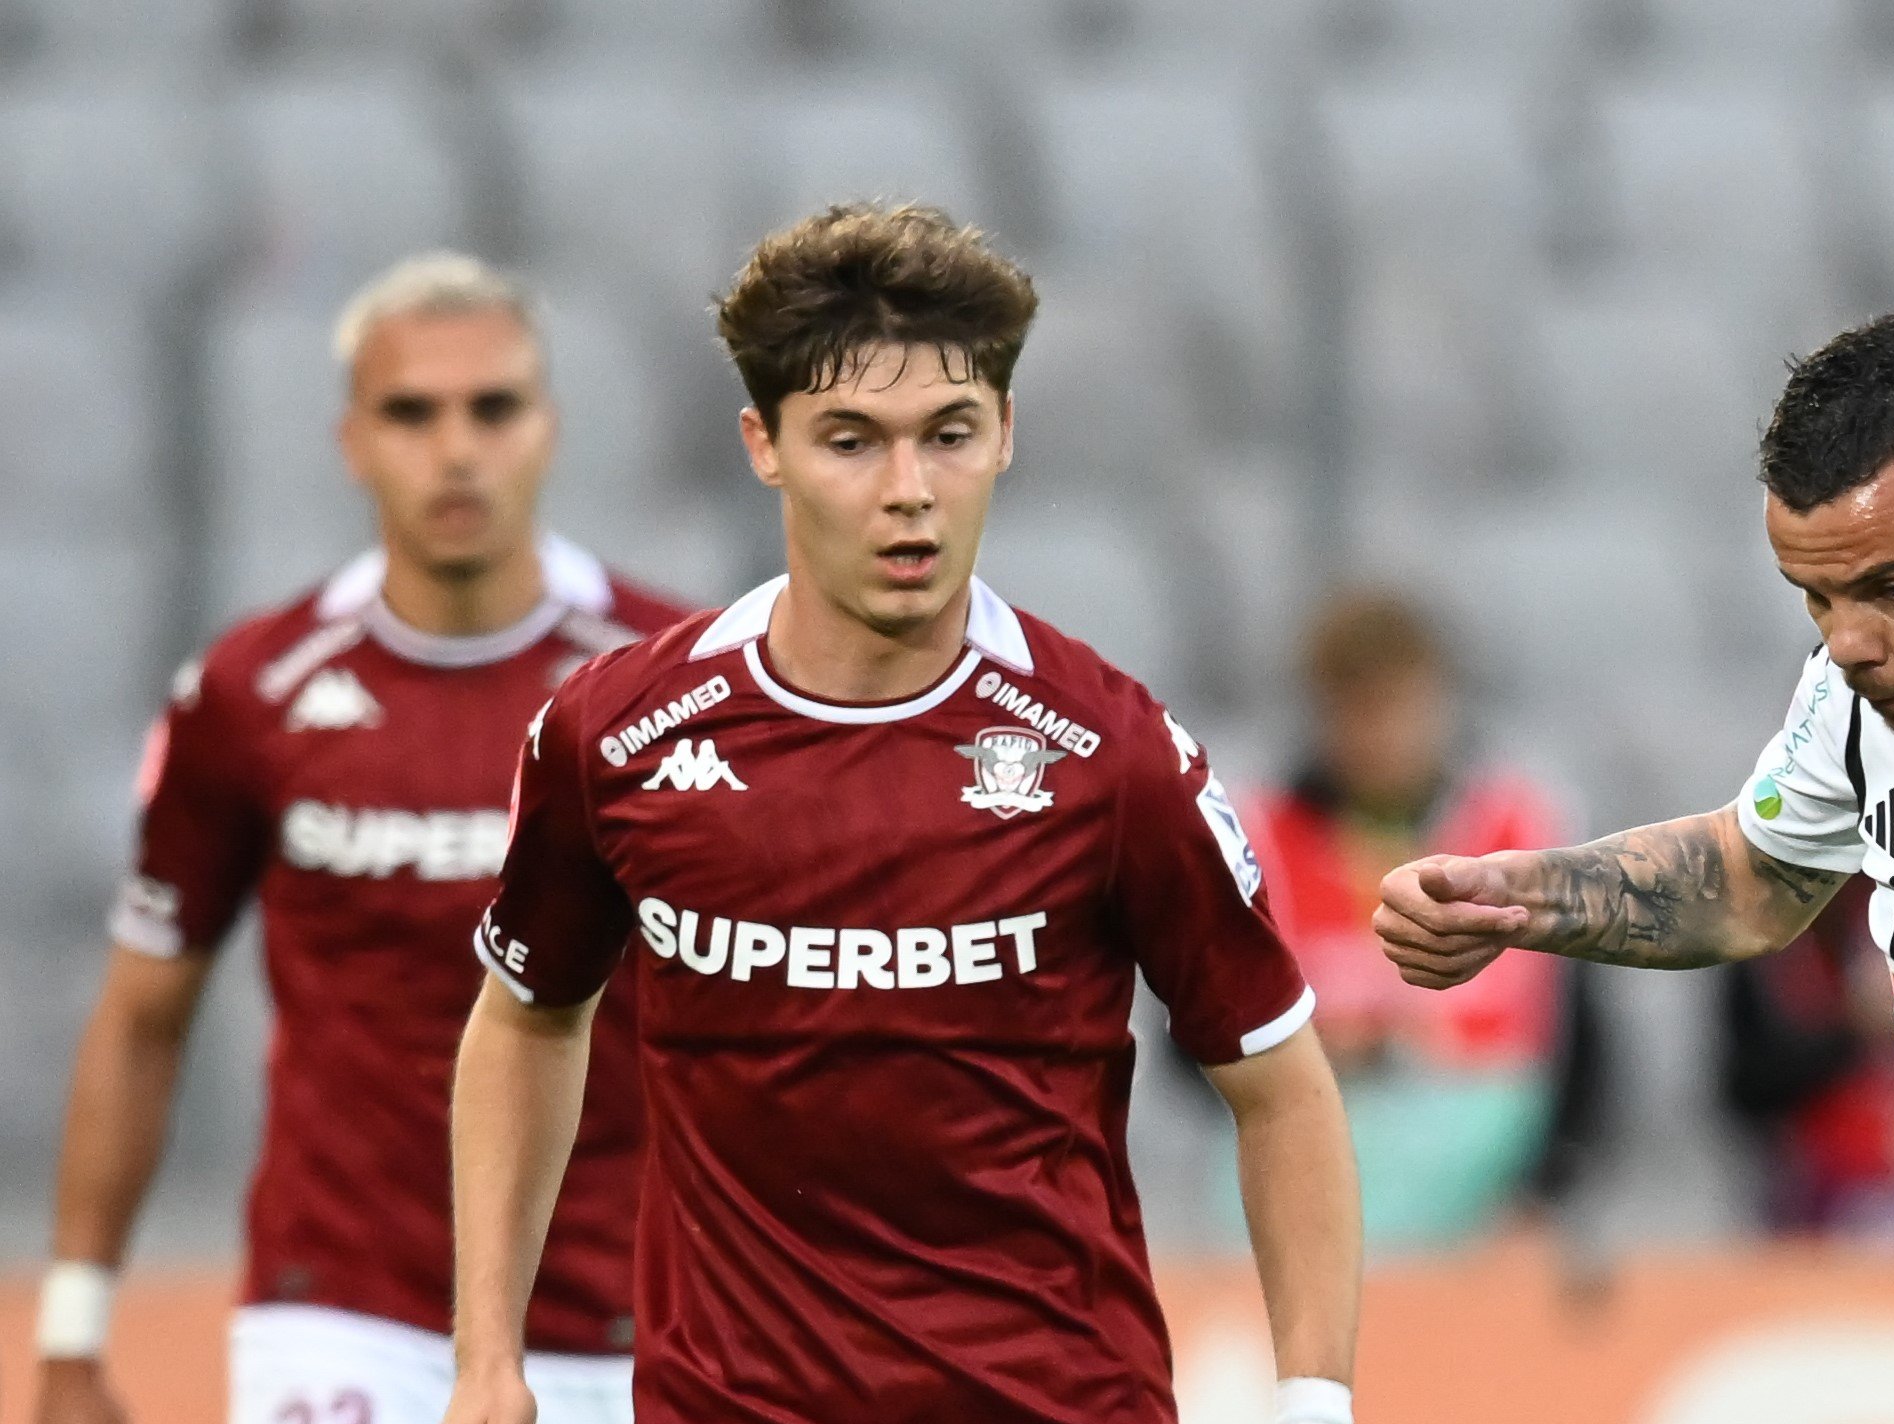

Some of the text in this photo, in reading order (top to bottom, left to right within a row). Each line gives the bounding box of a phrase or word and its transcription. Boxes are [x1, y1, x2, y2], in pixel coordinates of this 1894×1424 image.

[623, 674, 731, 756] IMAMED
[992, 682, 1100, 758] IMAMED
[638, 896, 1047, 990] SUPERBET
